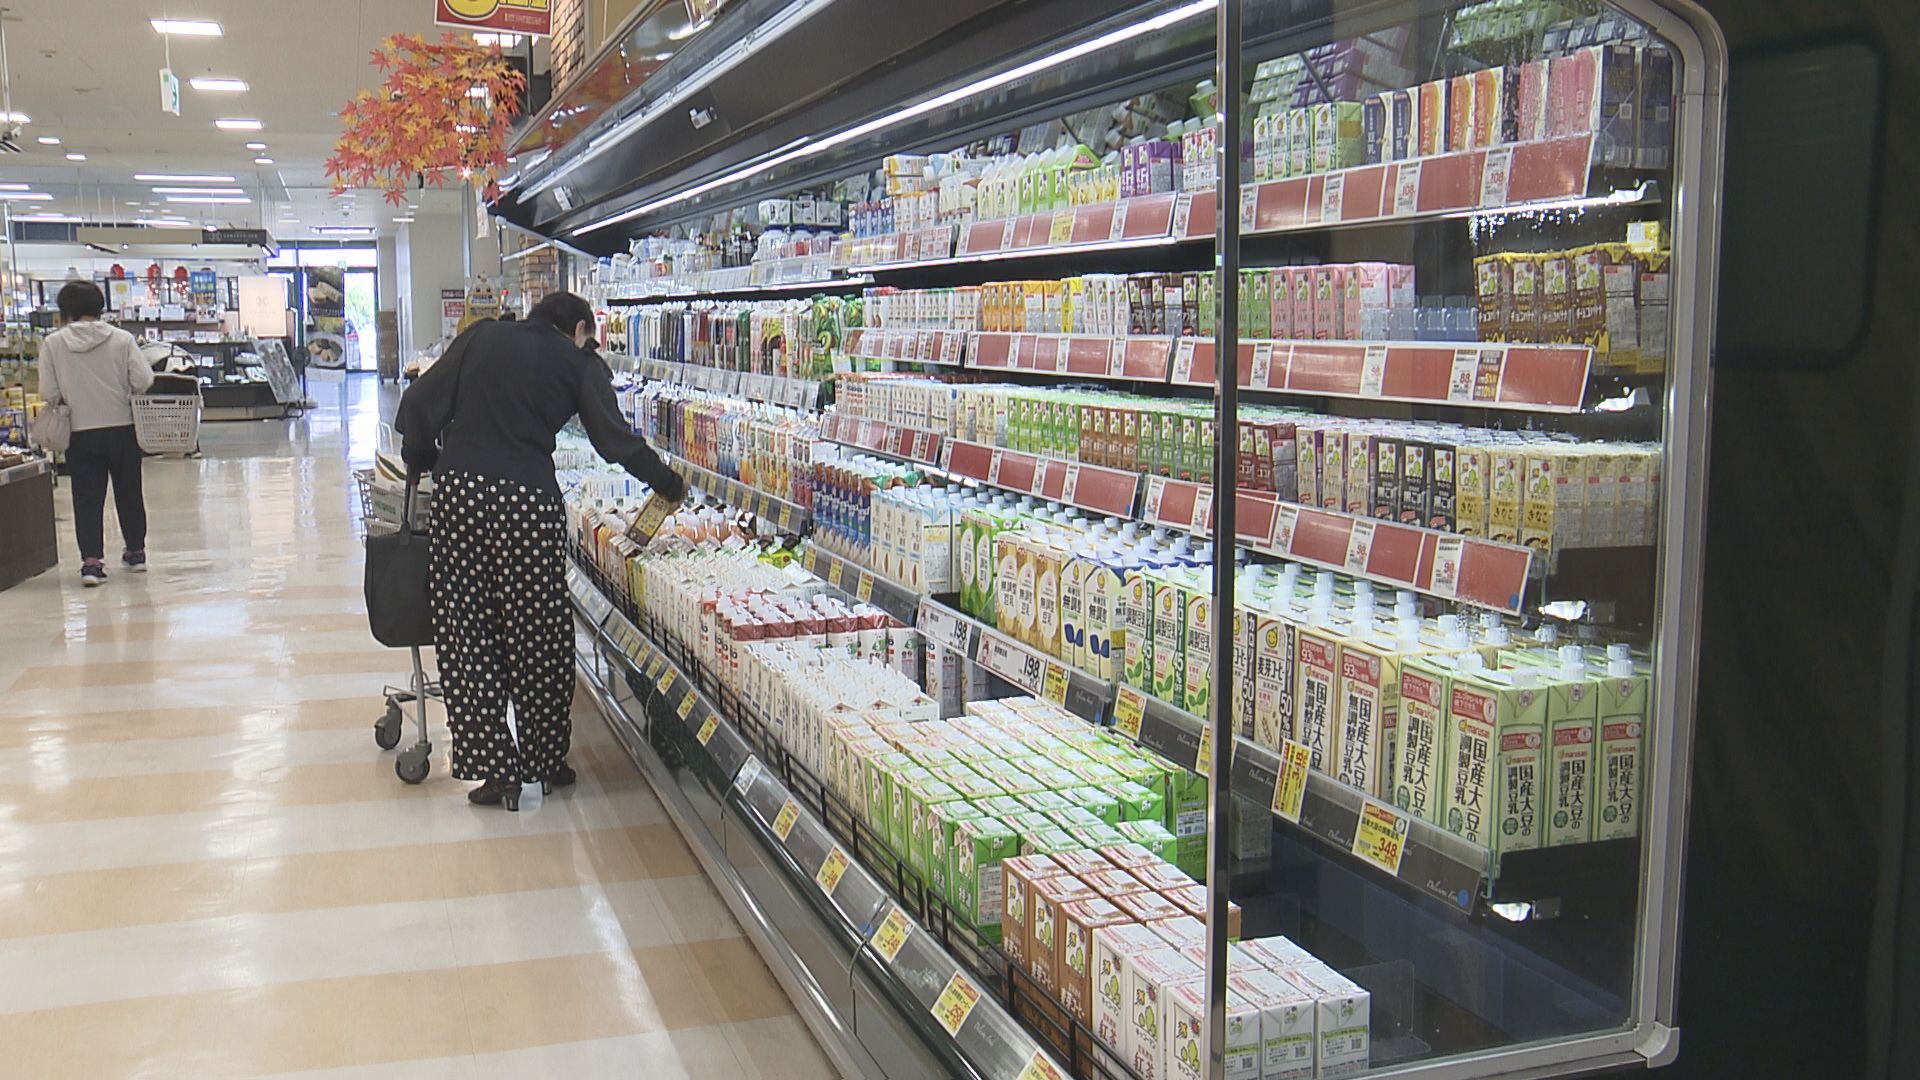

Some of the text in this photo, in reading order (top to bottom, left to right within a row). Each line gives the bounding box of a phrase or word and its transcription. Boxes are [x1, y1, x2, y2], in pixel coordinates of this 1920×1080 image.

[954, 619, 968, 640] 198
[1023, 654, 1040, 679] 198
[1402, 715, 1420, 784] 調製豆乳
[1454, 733, 1473, 807] 調製豆乳
[1466, 738, 1487, 843] 国産大豆の
[1519, 764, 1535, 837] 国産大豆の
[1571, 759, 1586, 830] 国産大豆の
[1619, 754, 1634, 825] 国産大豆の
[1378, 837, 1398, 858] 348
[1099, 1019, 1117, 1049] 紅茶
[1134, 1050, 1154, 1080] 紅茶
